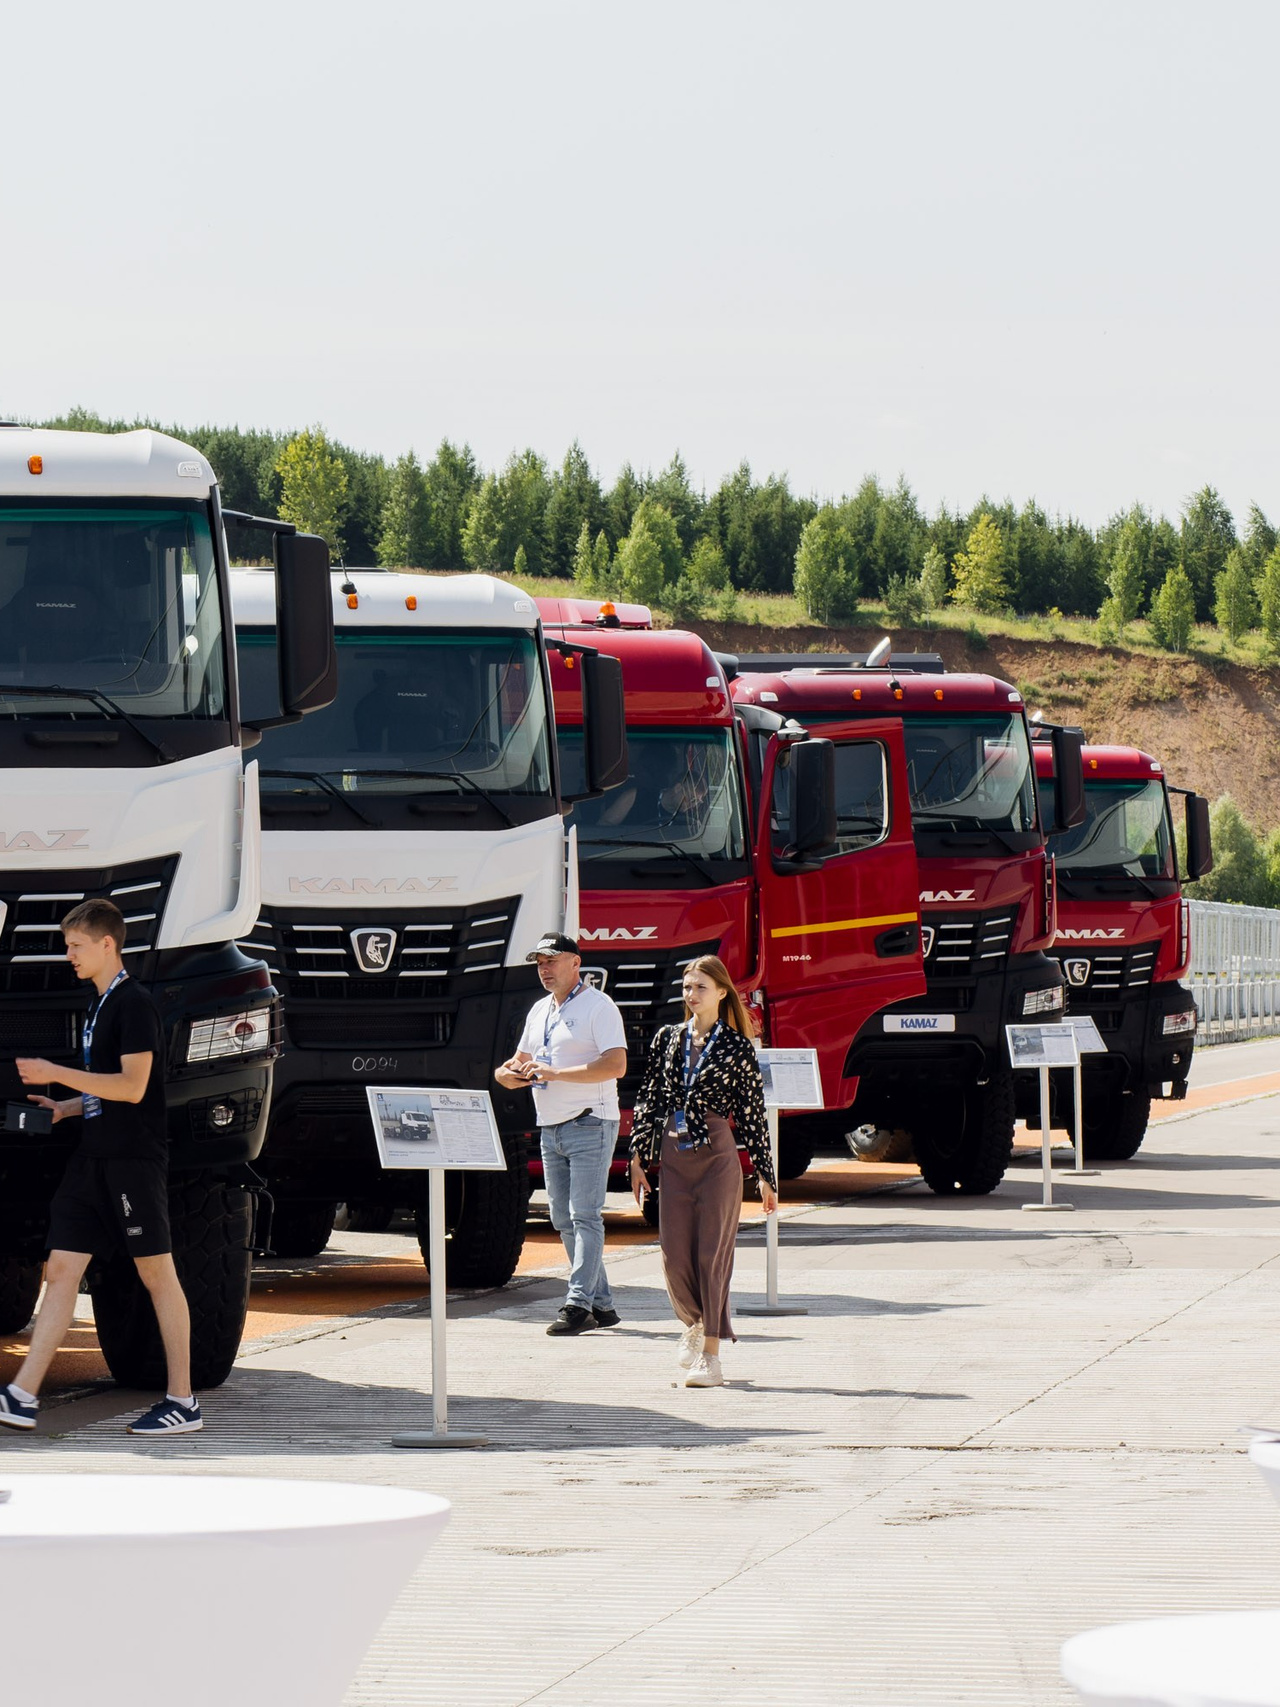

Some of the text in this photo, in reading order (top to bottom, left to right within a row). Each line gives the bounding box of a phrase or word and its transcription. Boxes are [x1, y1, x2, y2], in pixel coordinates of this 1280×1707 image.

[288, 876, 459, 895] KAMAZ
[578, 926, 659, 941] MAZ
[1054, 928, 1126, 939] AMAZ
[900, 1018, 938, 1029] KAMAZ
